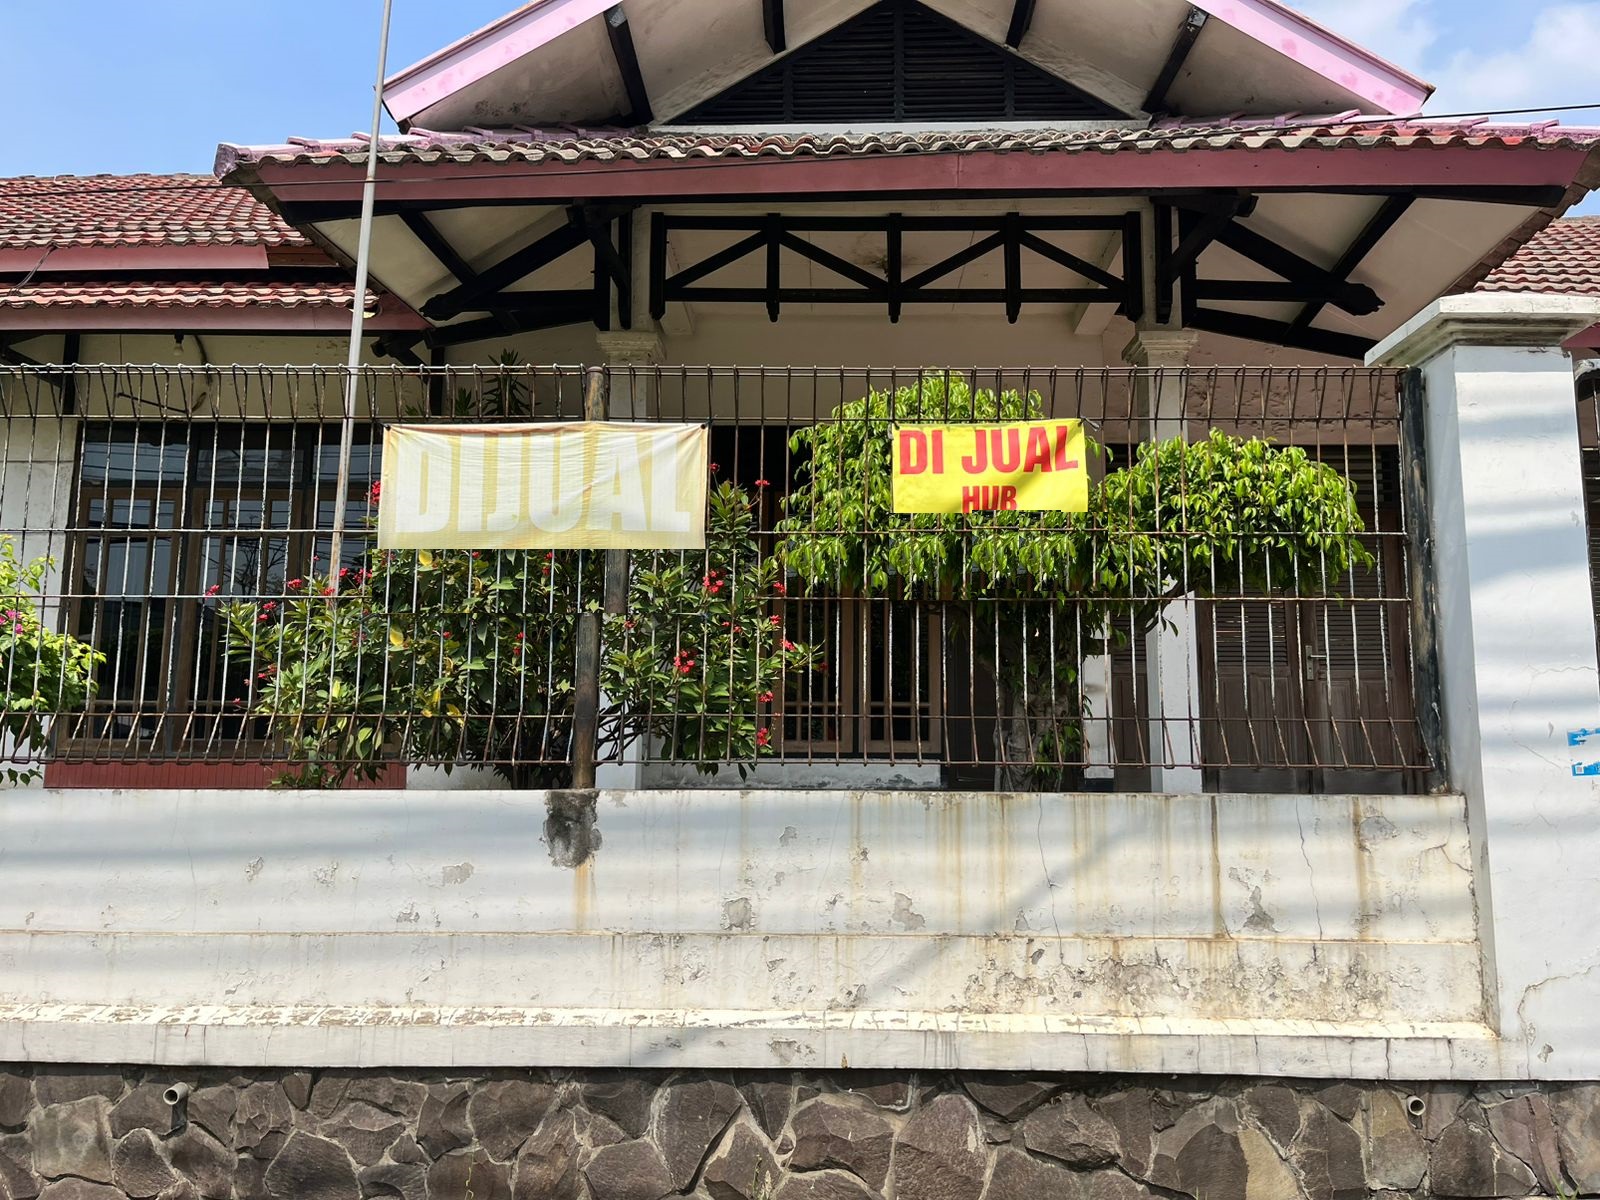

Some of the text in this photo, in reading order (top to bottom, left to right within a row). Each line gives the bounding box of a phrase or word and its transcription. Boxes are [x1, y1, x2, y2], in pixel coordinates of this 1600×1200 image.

[899, 425, 1079, 475] DI JUAL
[395, 431, 691, 533] DIJUAL
[962, 485, 1018, 513] HUB
